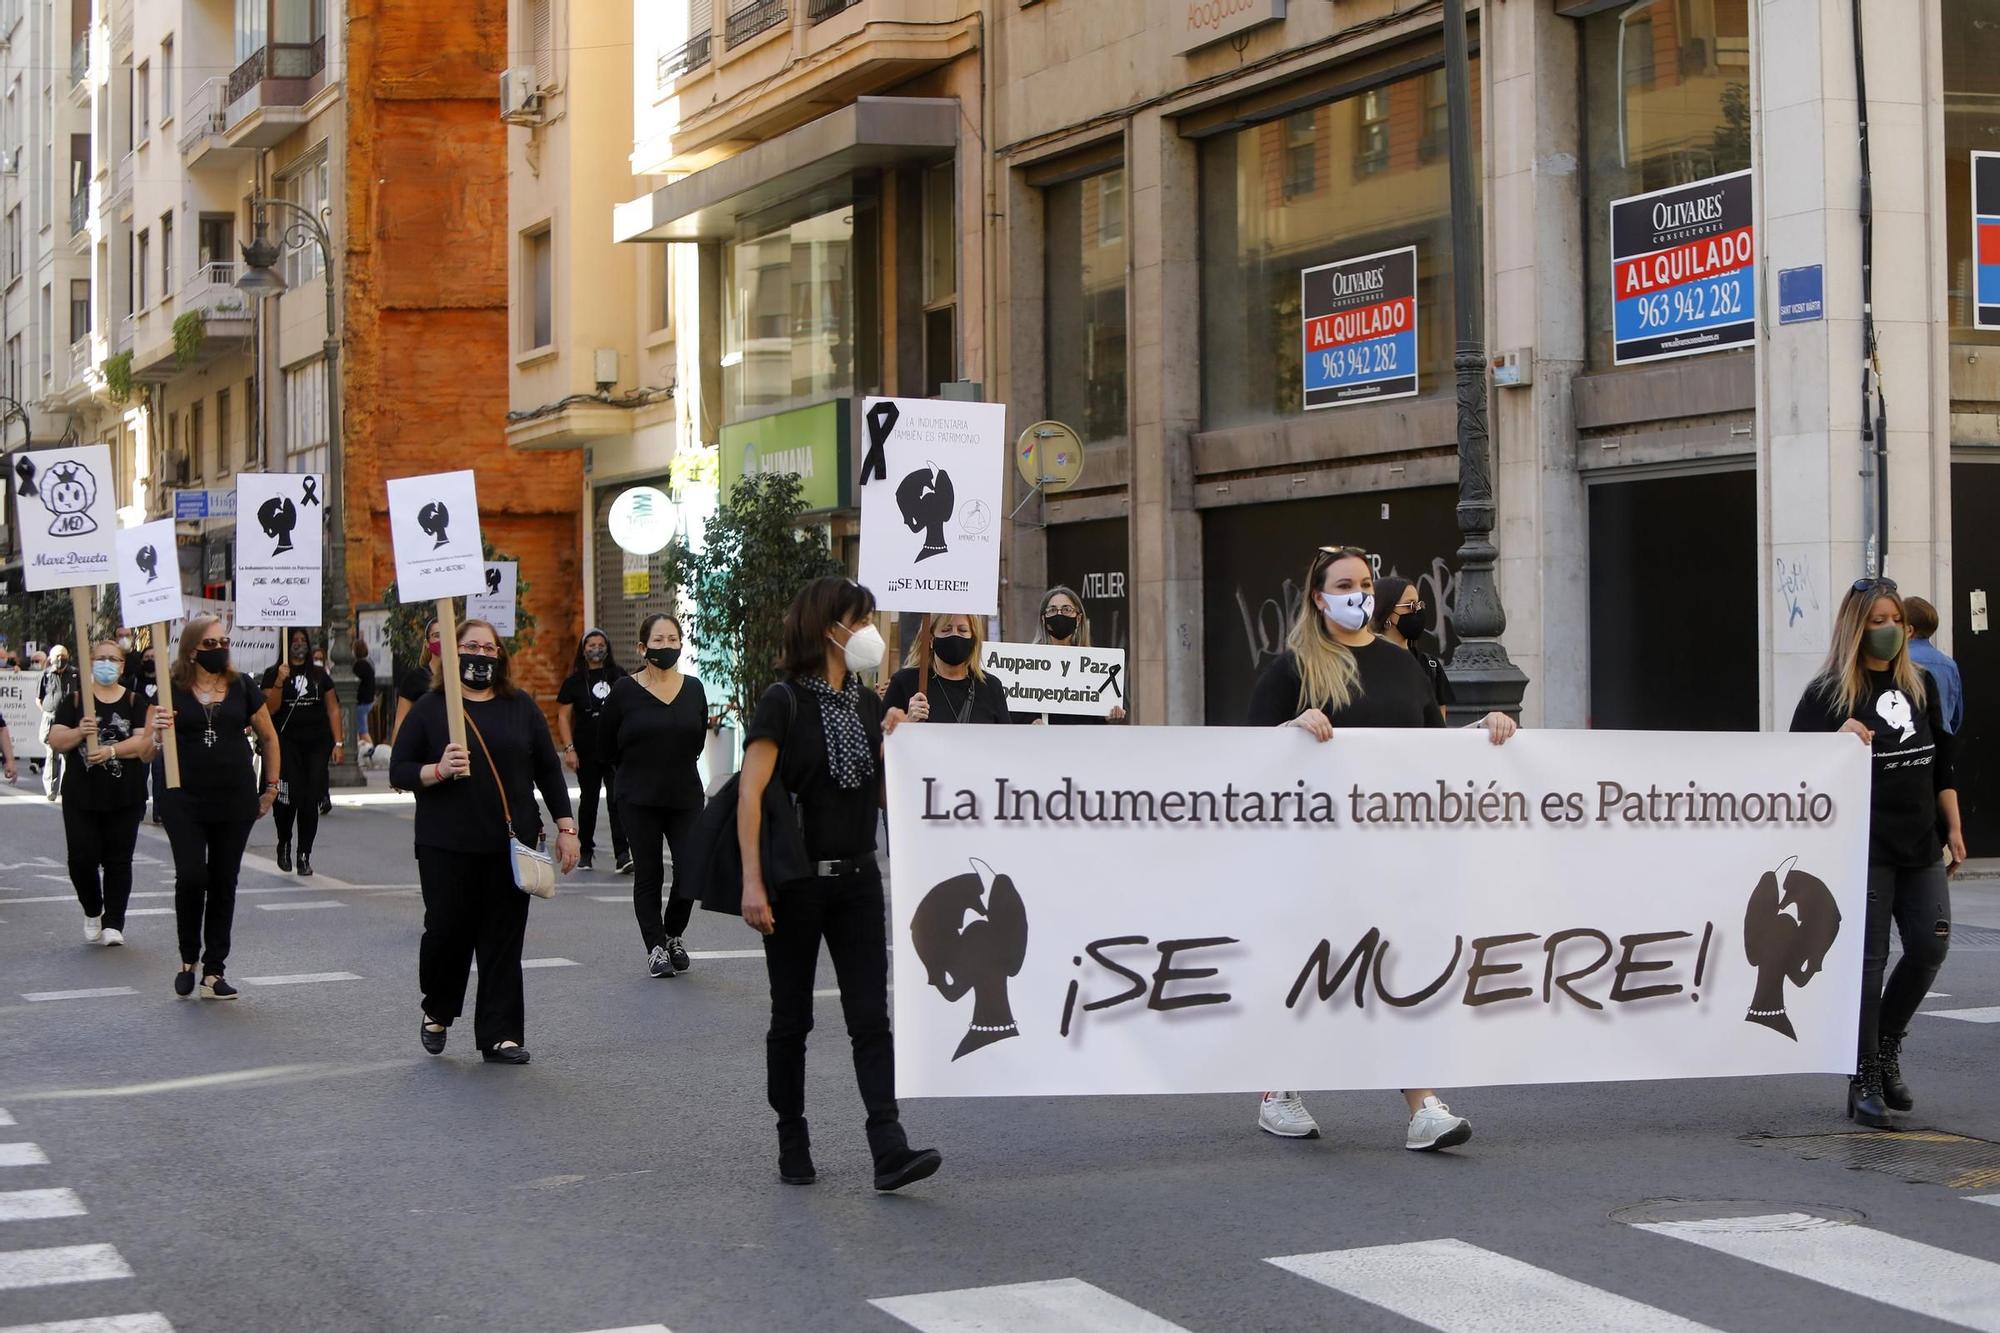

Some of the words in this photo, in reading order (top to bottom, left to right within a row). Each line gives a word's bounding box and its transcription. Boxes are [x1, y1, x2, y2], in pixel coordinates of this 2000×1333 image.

[1652, 193, 1723, 230] OLIVARES
[1652, 222, 1724, 244] CONSULTORES
[1625, 231, 1752, 293] ALQUILADO
[1332, 267, 1384, 297] OLIVARES
[1638, 293, 1671, 330] 963
[1674, 287, 1705, 328] 942
[1709, 280, 1742, 318] 282
[1313, 302, 1406, 347] ALQUILADO
[1322, 350, 1345, 380] 963
[1347, 347, 1371, 377] 942
[1373, 342, 1398, 373] 282
[761, 445, 814, 479] HUMANA
[888, 578, 913, 592] ¡¡¡SE
[915, 578, 969, 592] MUERE!!!
[1081, 571, 1126, 599] ATELIER
[260, 608, 297, 617] Sendra
[231, 640, 275, 650] valenciana
[987, 651, 1052, 675] Amparo
[1060, 660, 1071, 678] y
[1079, 656, 1110, 675] Paz
[1001, 681, 1100, 704] ndumentaria
[921, 777, 980, 821] La
[993, 776, 1336, 824] Indumentaria
[1348, 778, 1529, 824] también
[1540, 791, 1584, 824] es
[1595, 779, 1834, 824] Patrimonio
[1060, 935, 1241, 1038] ¡SE
[1285, 921, 1714, 1011] MUERE!
